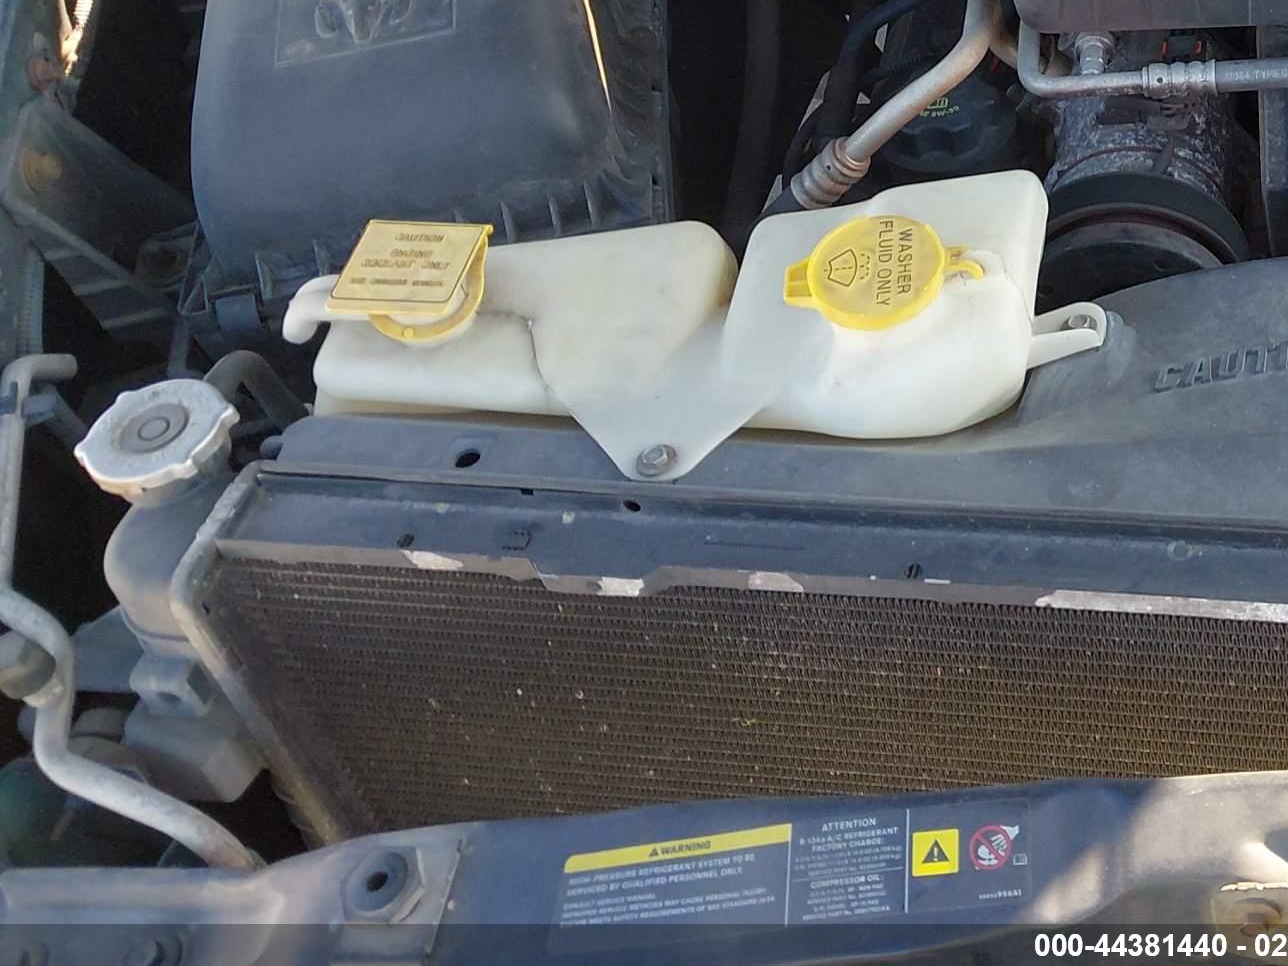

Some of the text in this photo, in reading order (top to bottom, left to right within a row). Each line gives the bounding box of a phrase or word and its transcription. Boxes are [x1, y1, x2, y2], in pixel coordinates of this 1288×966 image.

[875, 220, 894, 307] FLUID ONLY
[896, 227, 913, 295] WASHER
[821, 817, 877, 833] ATTENTION
[660, 840, 712, 856] WARNING
